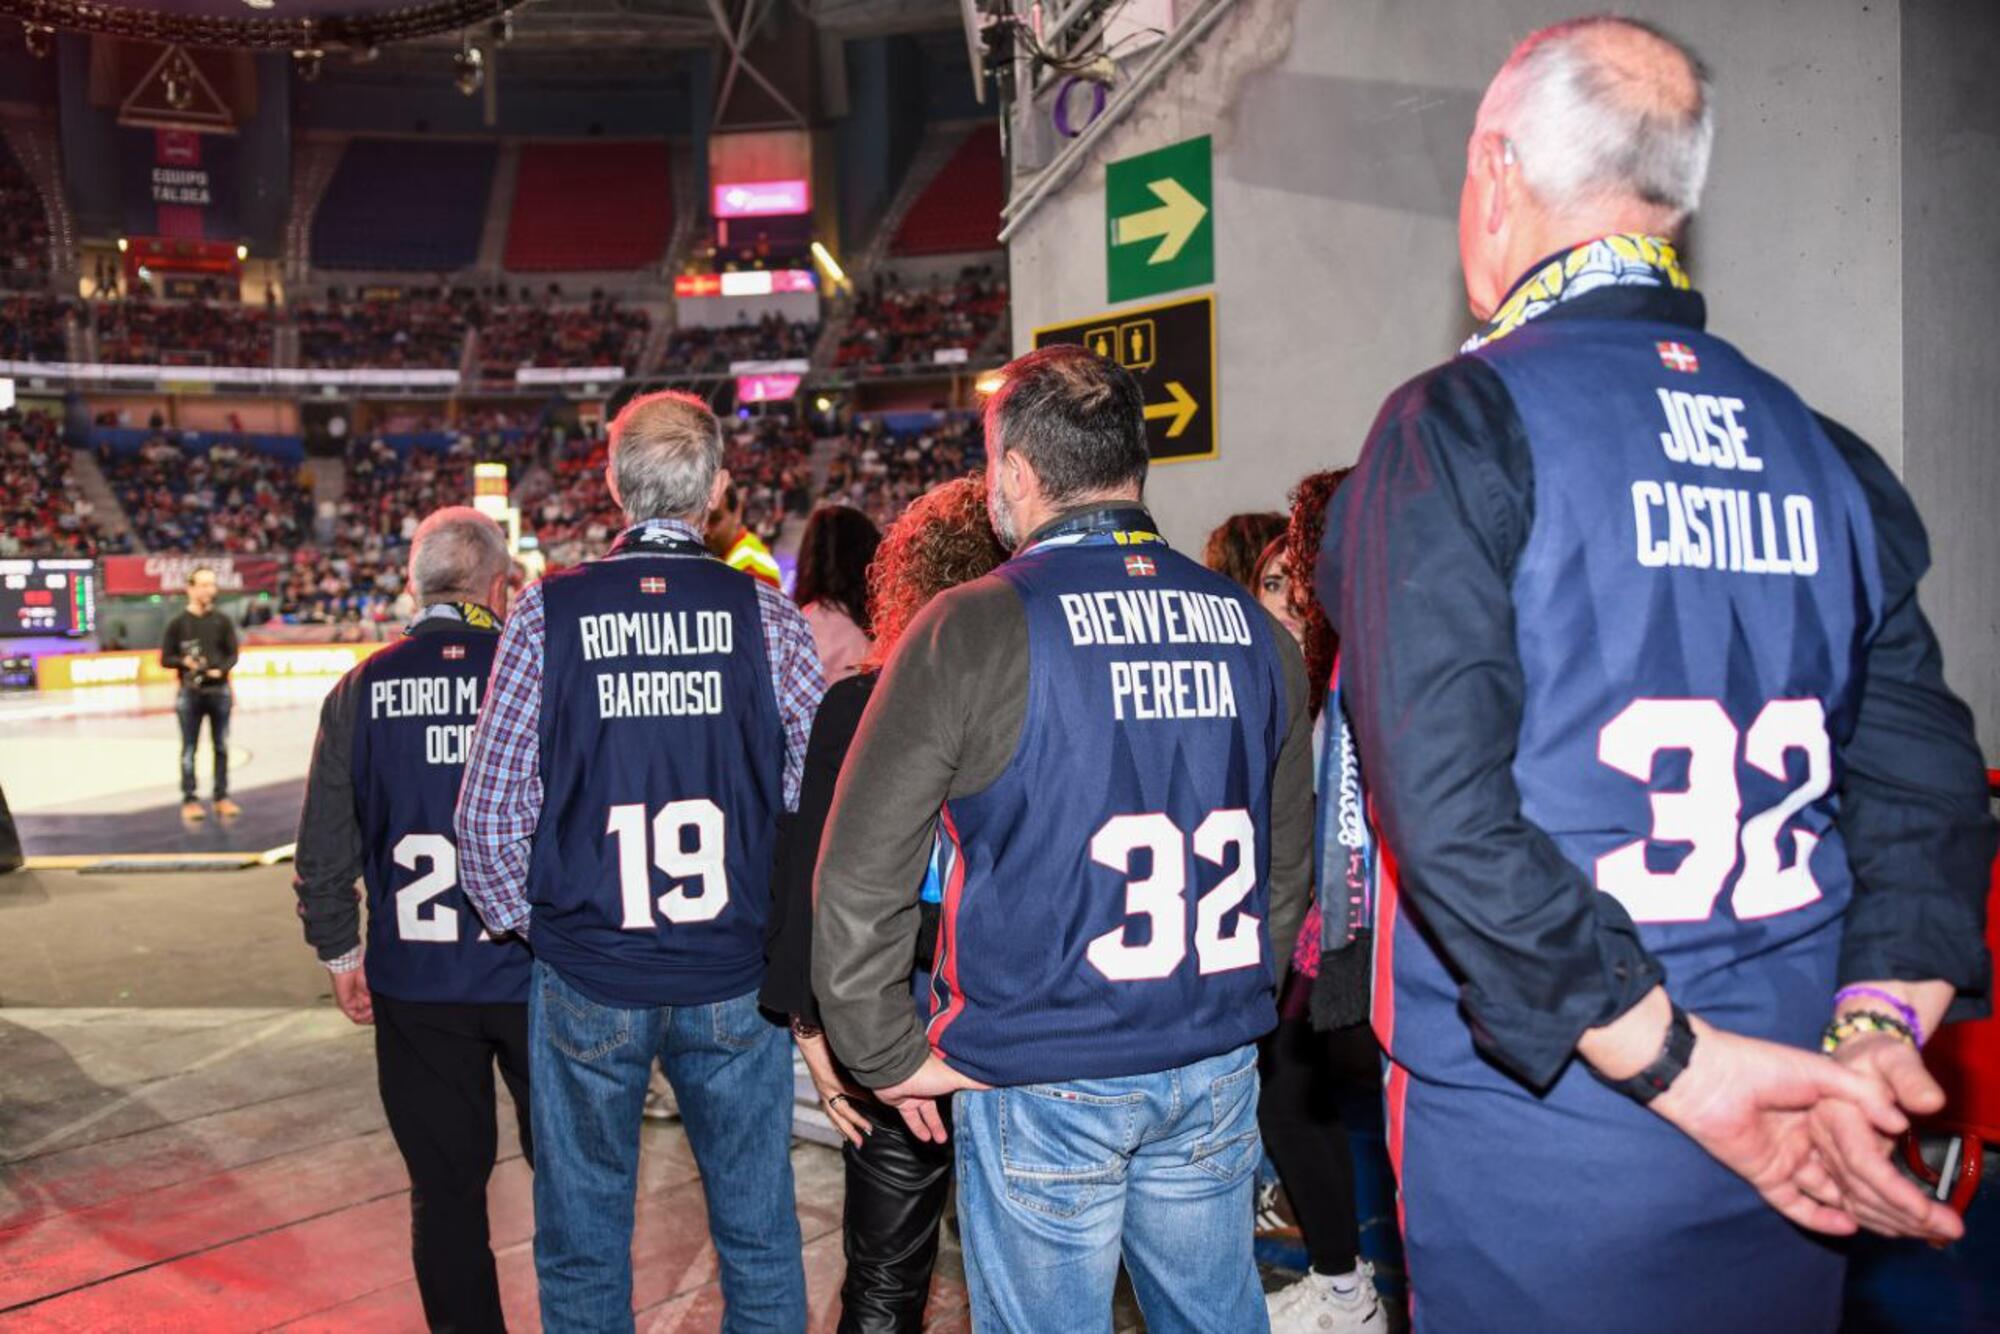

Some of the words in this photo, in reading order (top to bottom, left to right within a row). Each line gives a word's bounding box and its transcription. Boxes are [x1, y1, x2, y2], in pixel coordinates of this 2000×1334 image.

[152, 167, 209, 187] EQUIPO
[1656, 388, 1763, 471] JOSE
[1631, 481, 1819, 576] CASTILLO
[579, 611, 733, 661] ROMUALDO
[1058, 589, 1253, 647] BIENVENIDO
[371, 677, 450, 719] PEDRO
[597, 670, 722, 720] BARROSO
[1110, 660, 1238, 721] PEREDA
[1596, 698, 1832, 923] 32
[393, 834, 491, 943] 2
[605, 799, 730, 930] 19
[1086, 808, 1262, 982] 32
